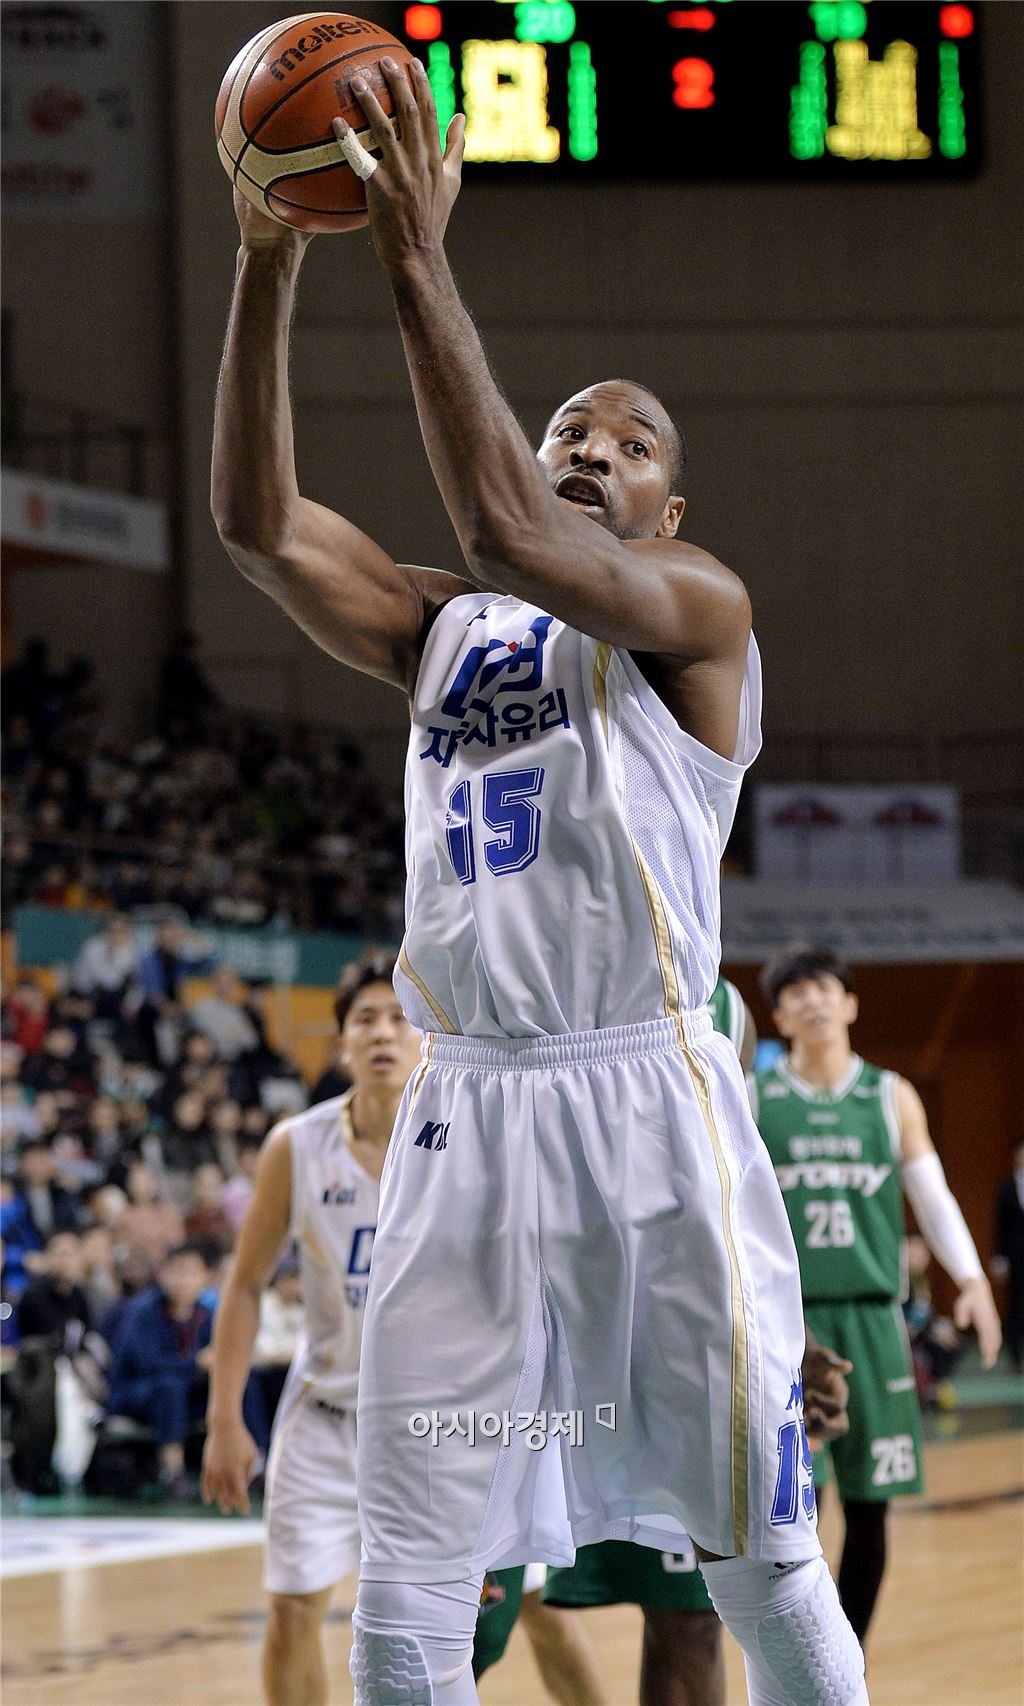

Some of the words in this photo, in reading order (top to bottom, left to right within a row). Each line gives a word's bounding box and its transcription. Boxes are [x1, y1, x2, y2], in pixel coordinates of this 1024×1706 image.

[270, 20, 380, 81] molten
[446, 767, 545, 887] 15
[804, 1200, 855, 1248] 26
[871, 1433, 917, 1486] 26
